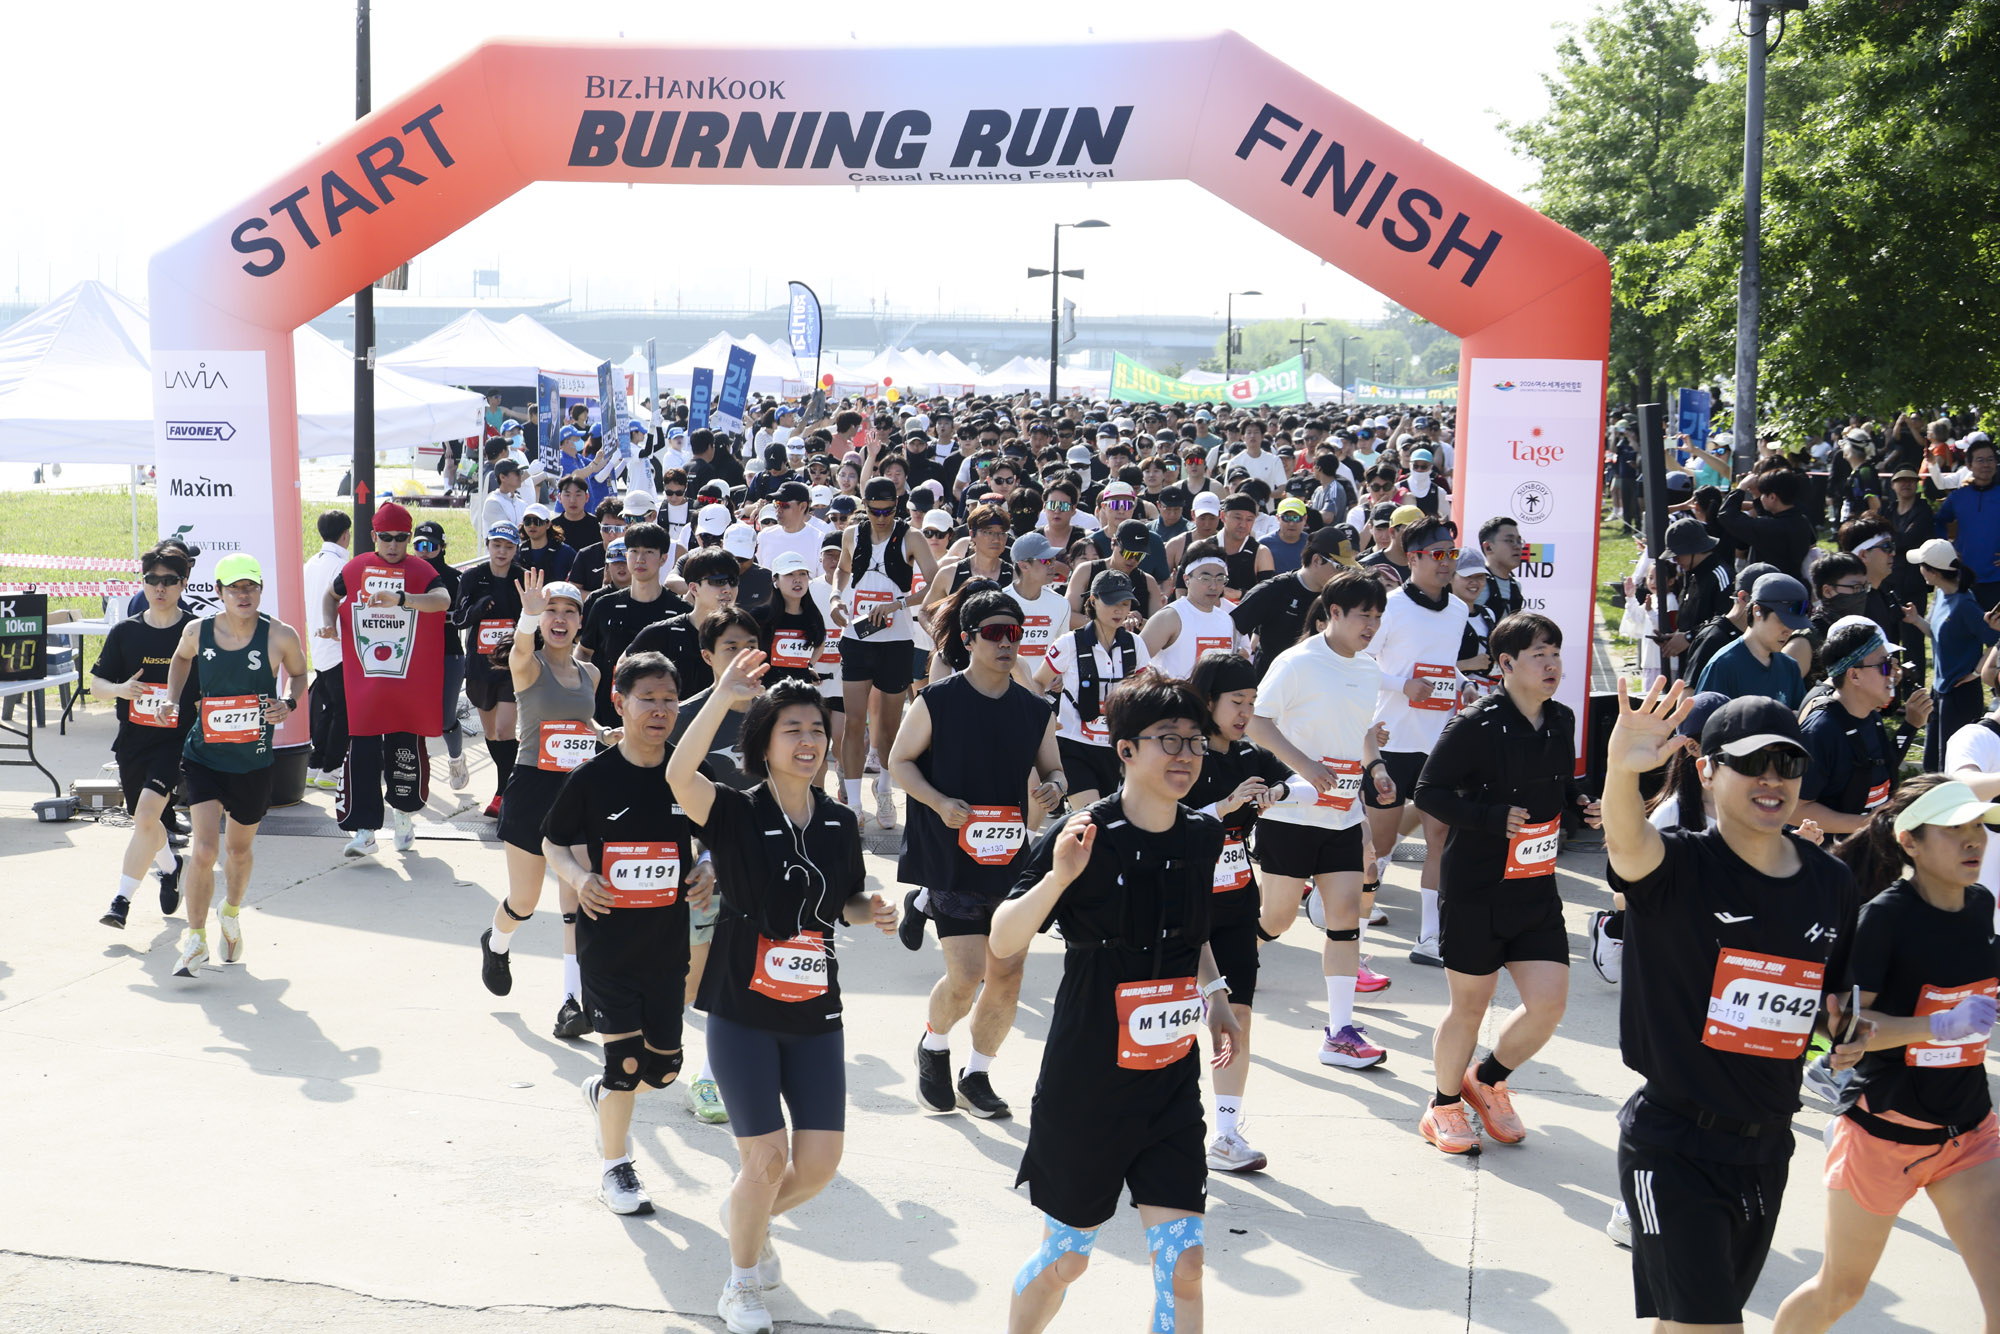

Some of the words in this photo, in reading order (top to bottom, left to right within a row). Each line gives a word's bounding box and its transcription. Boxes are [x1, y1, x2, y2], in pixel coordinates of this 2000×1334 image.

[568, 109, 932, 169] BURNING
[949, 105, 1134, 168] RUN
[848, 172, 922, 182] Casual
[929, 171, 1022, 182] Running
[1028, 168, 1114, 180] Festival
[231, 103, 455, 278] START
[1234, 102, 1503, 288] FINISH
[169, 425, 223, 438] FAVONEX
[1507, 440, 1564, 467] Tage
[169, 475, 233, 497] Maxim
[1516, 483, 1549, 496] SUNBODY
[1519, 512, 1546, 522] TANNING
[495, 527, 514, 536] HOKA
[1511, 562, 1554, 578] IND
[185, 582, 214, 593] eeb
[378, 580, 402, 590] 1114
[5, 619, 37, 634] 10km
[362, 619, 405, 629] KETCHUP
[1024, 629, 1049, 638] 1679
[790, 642, 813, 651] 41
[142, 656, 172, 665] Nassa
[247, 649, 262, 671] S
[224, 711, 258, 724] 2717
[551, 740, 561, 748] W
[563, 739, 596, 751] 3587
[972, 829, 983, 838] M
[985, 827, 1022, 840] 2751
[1522, 846, 1533, 856] M
[616, 868, 628, 878] M
[633, 865, 676, 879] 1191
[772, 956, 785, 967] W
[1732, 991, 1750, 1007] M
[1757, 991, 1817, 1018] 1642
[1139, 1016, 1153, 1030] M
[1158, 1005, 1201, 1029] 1464
[1708, 1002, 1745, 1023] D-119
